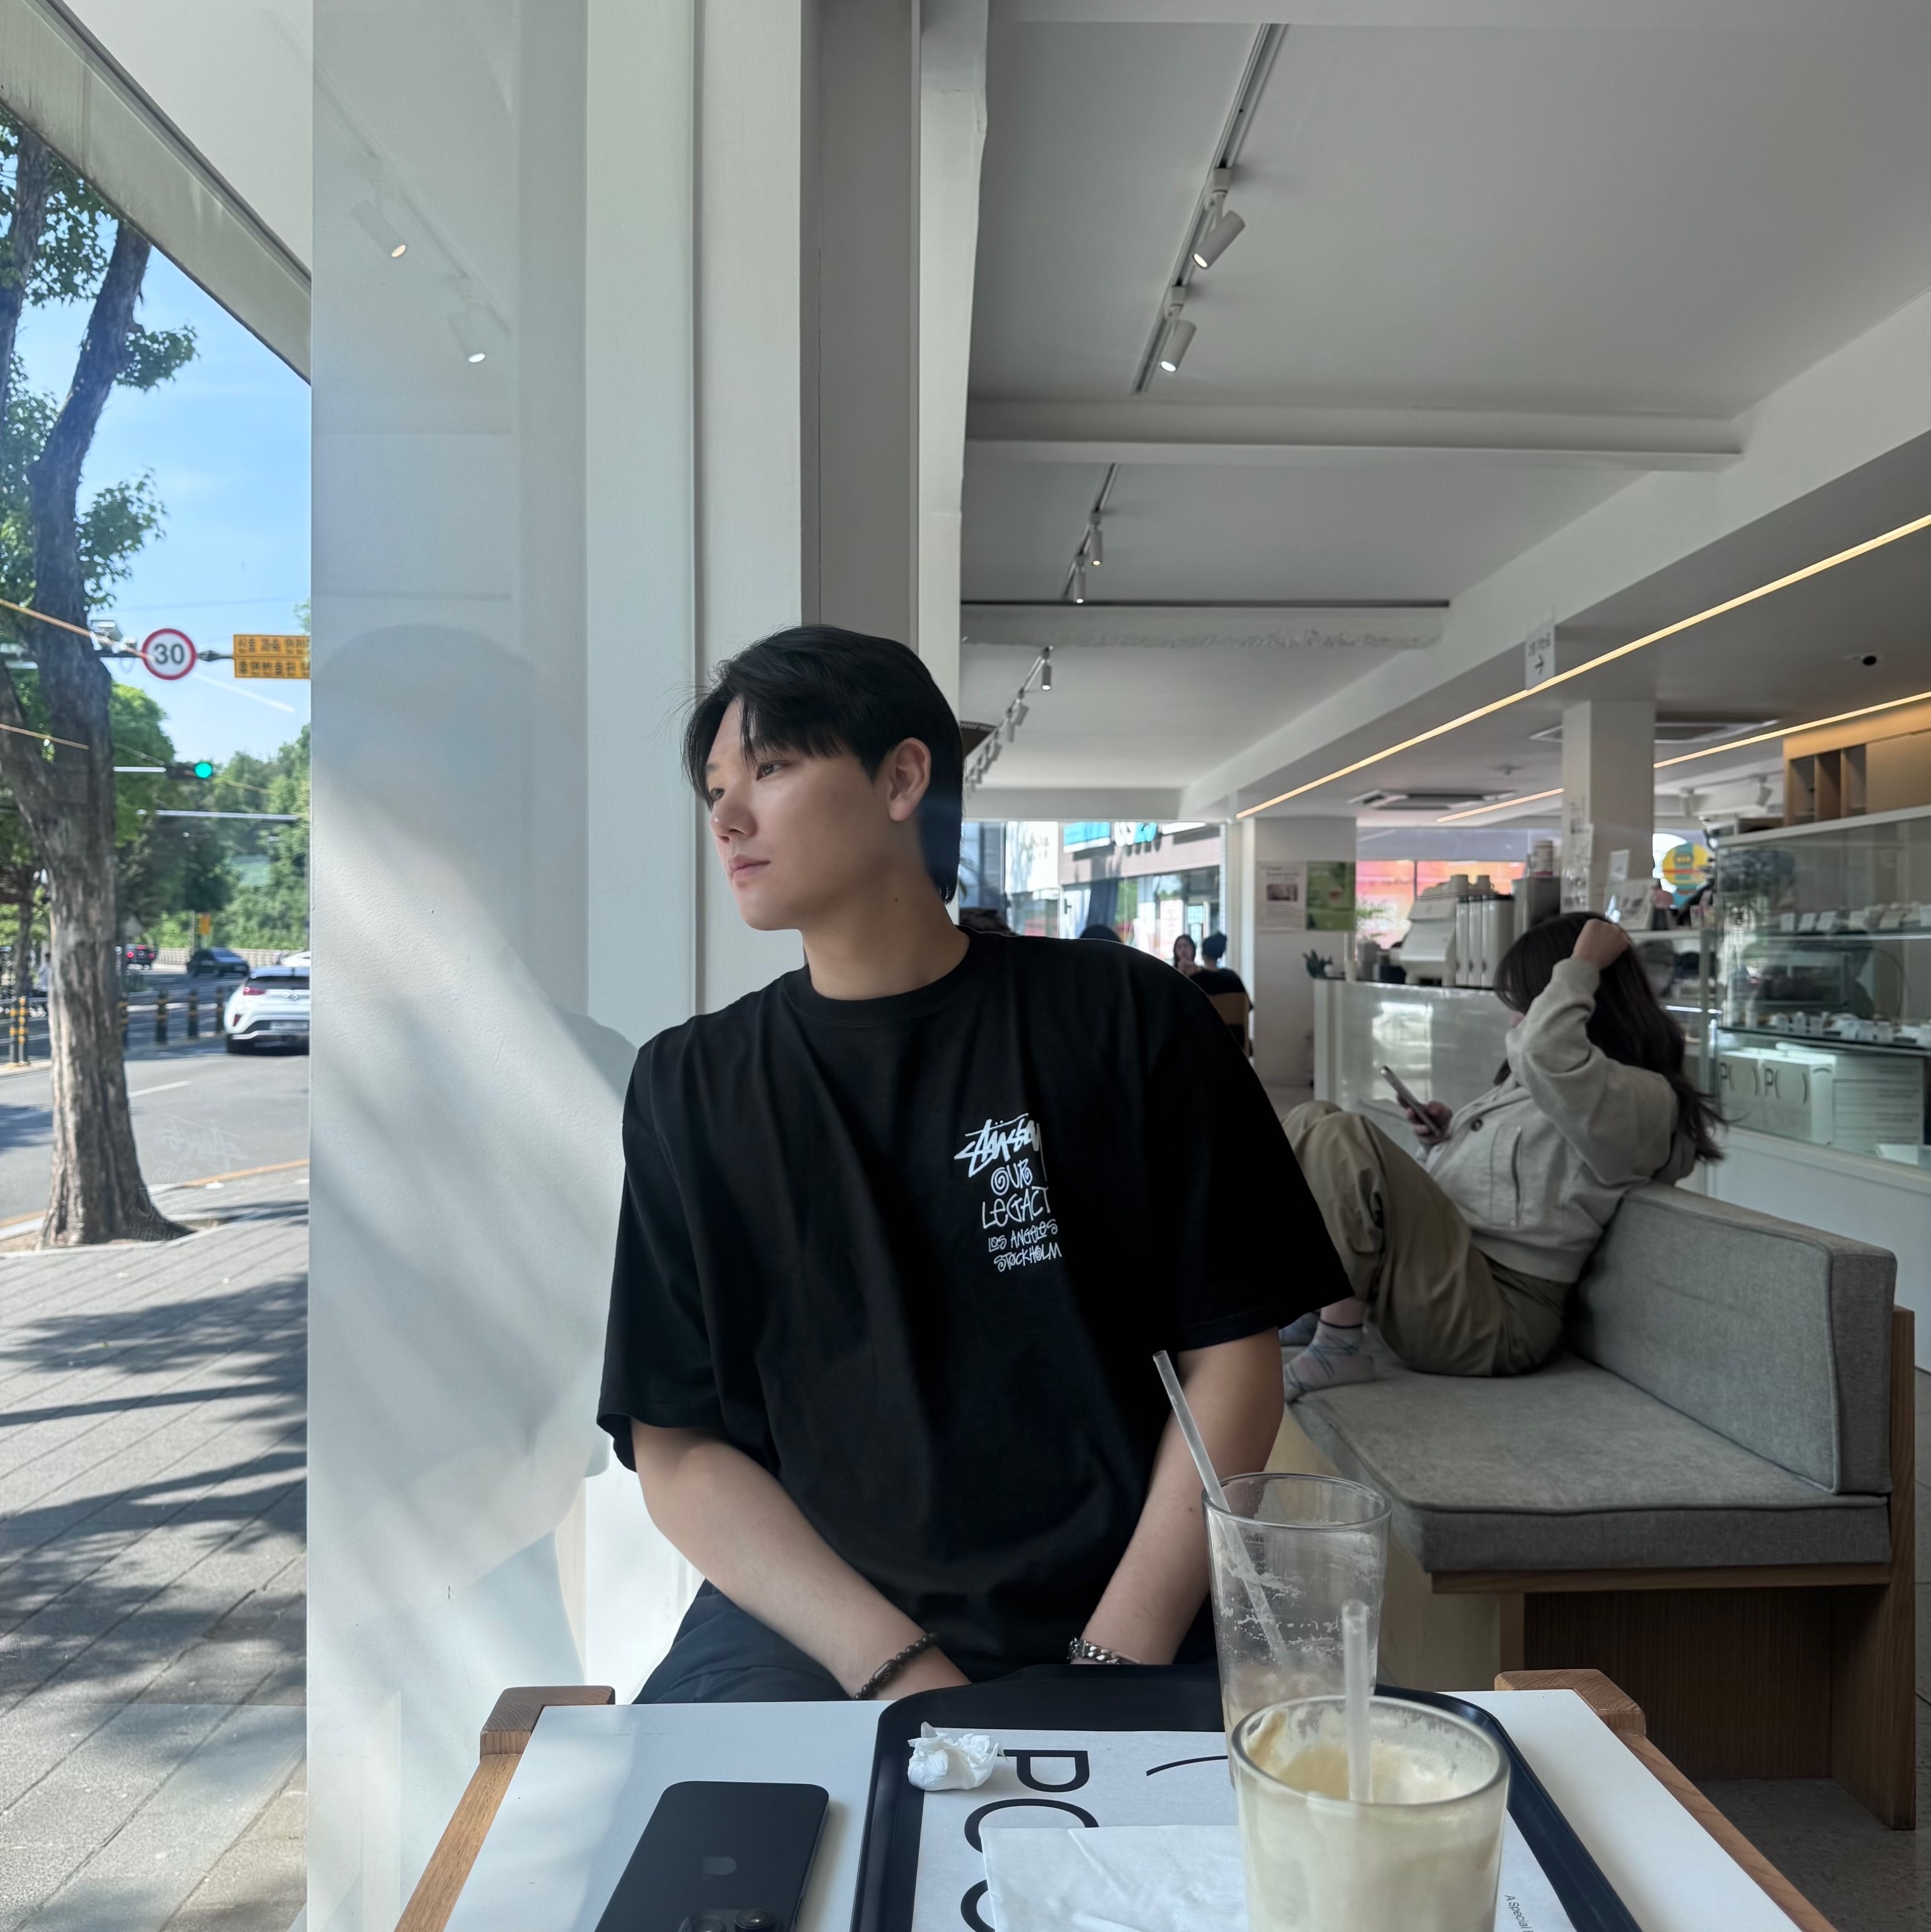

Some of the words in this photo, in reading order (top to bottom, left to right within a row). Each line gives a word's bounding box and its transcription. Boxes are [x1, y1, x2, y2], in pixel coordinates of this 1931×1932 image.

[154, 643, 185, 665] 30
[991, 1158, 1033, 1196] OUR
[988, 1235, 1007, 1252] LOS
[993, 1242, 1062, 1272] STOCKHOLM
[1508, 1902, 1532, 1929] Special
